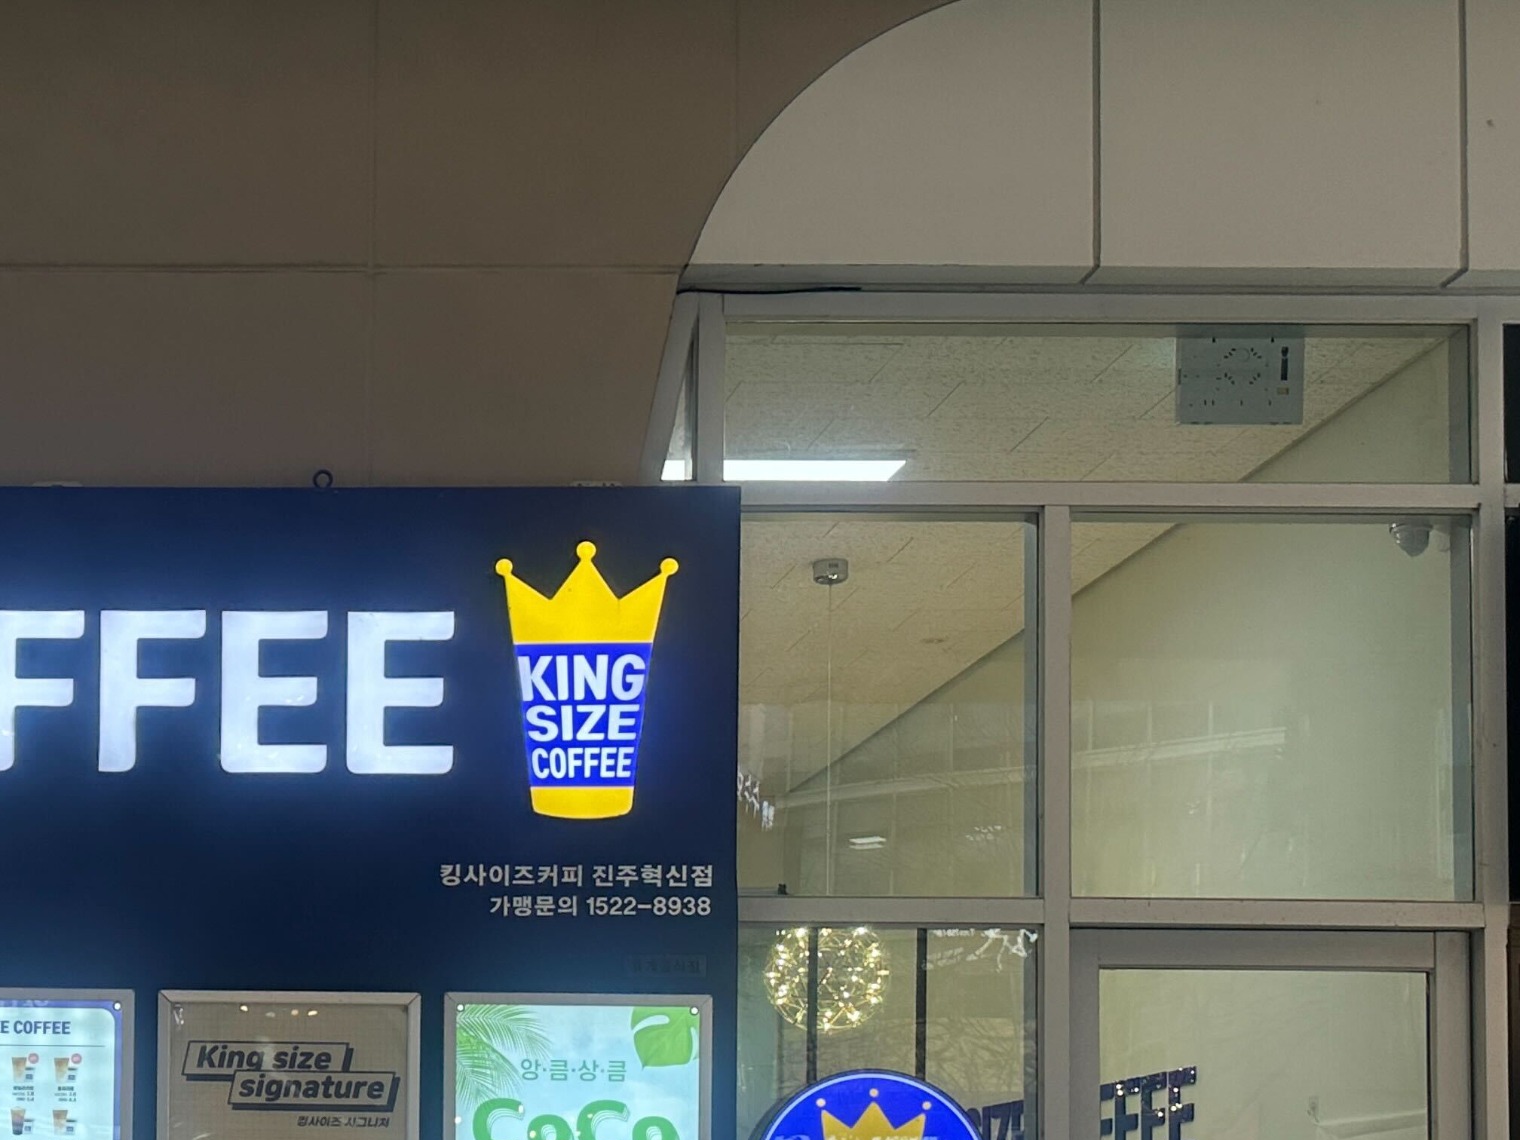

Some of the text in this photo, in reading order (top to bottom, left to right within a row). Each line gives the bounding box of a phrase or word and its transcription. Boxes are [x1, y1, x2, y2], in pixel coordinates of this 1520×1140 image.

[517, 654, 646, 701] KING
[526, 704, 640, 742] SIZE
[532, 747, 634, 779] COFFEE
[440, 864, 713, 888] 킹사이즈커피 진주혁신점
[490, 895, 711, 917] 가맹문의 1522-8938
[14, 1021, 71, 1034] COFFEE
[196, 1045, 332, 1070] King size
[238, 1074, 385, 1101] signature
